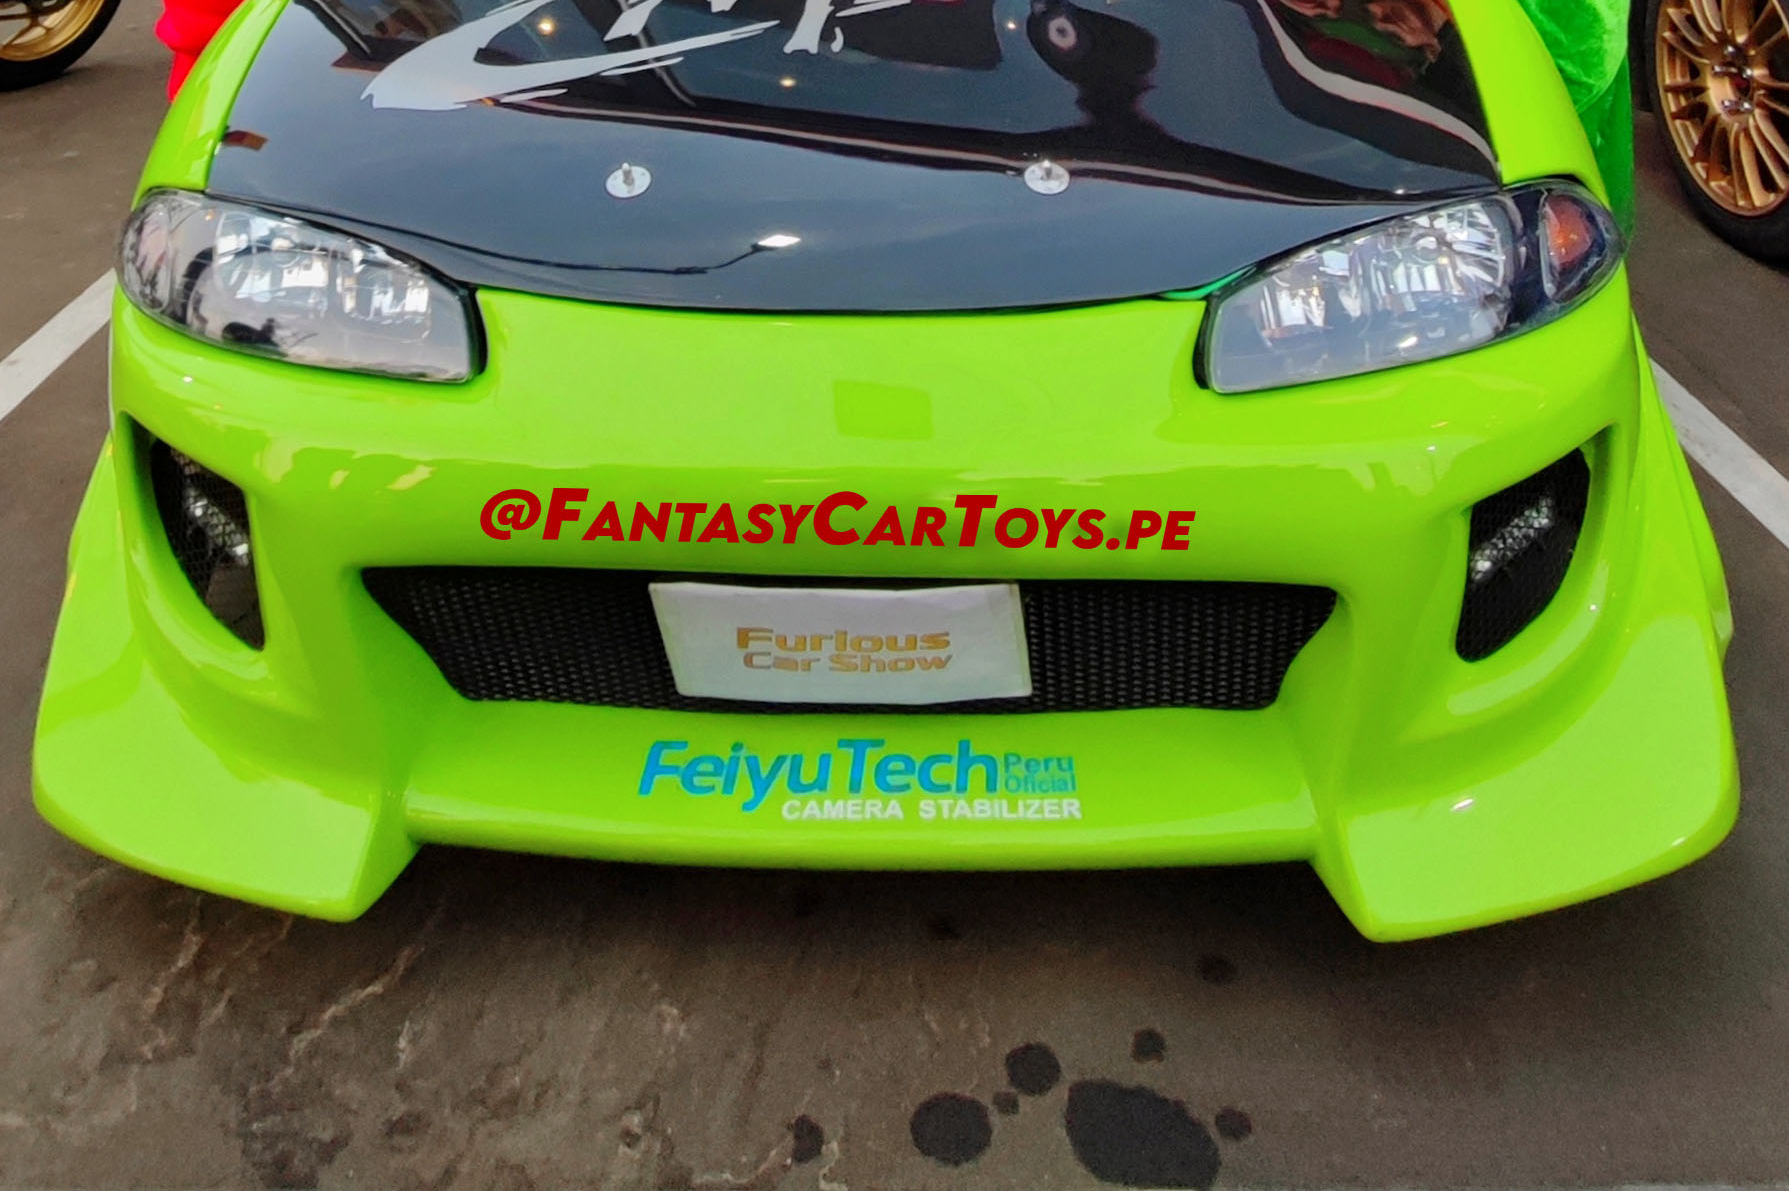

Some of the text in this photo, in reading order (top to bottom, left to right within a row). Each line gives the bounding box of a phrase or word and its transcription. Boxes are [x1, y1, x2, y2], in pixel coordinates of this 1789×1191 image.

[736, 626, 951, 653] Furious
[743, 651, 953, 672] Car Show
[1003, 751, 1075, 774] Peru
[637, 738, 998, 813] FeiyuTech
[780, 799, 1083, 820] CAMERA STABILIZER
